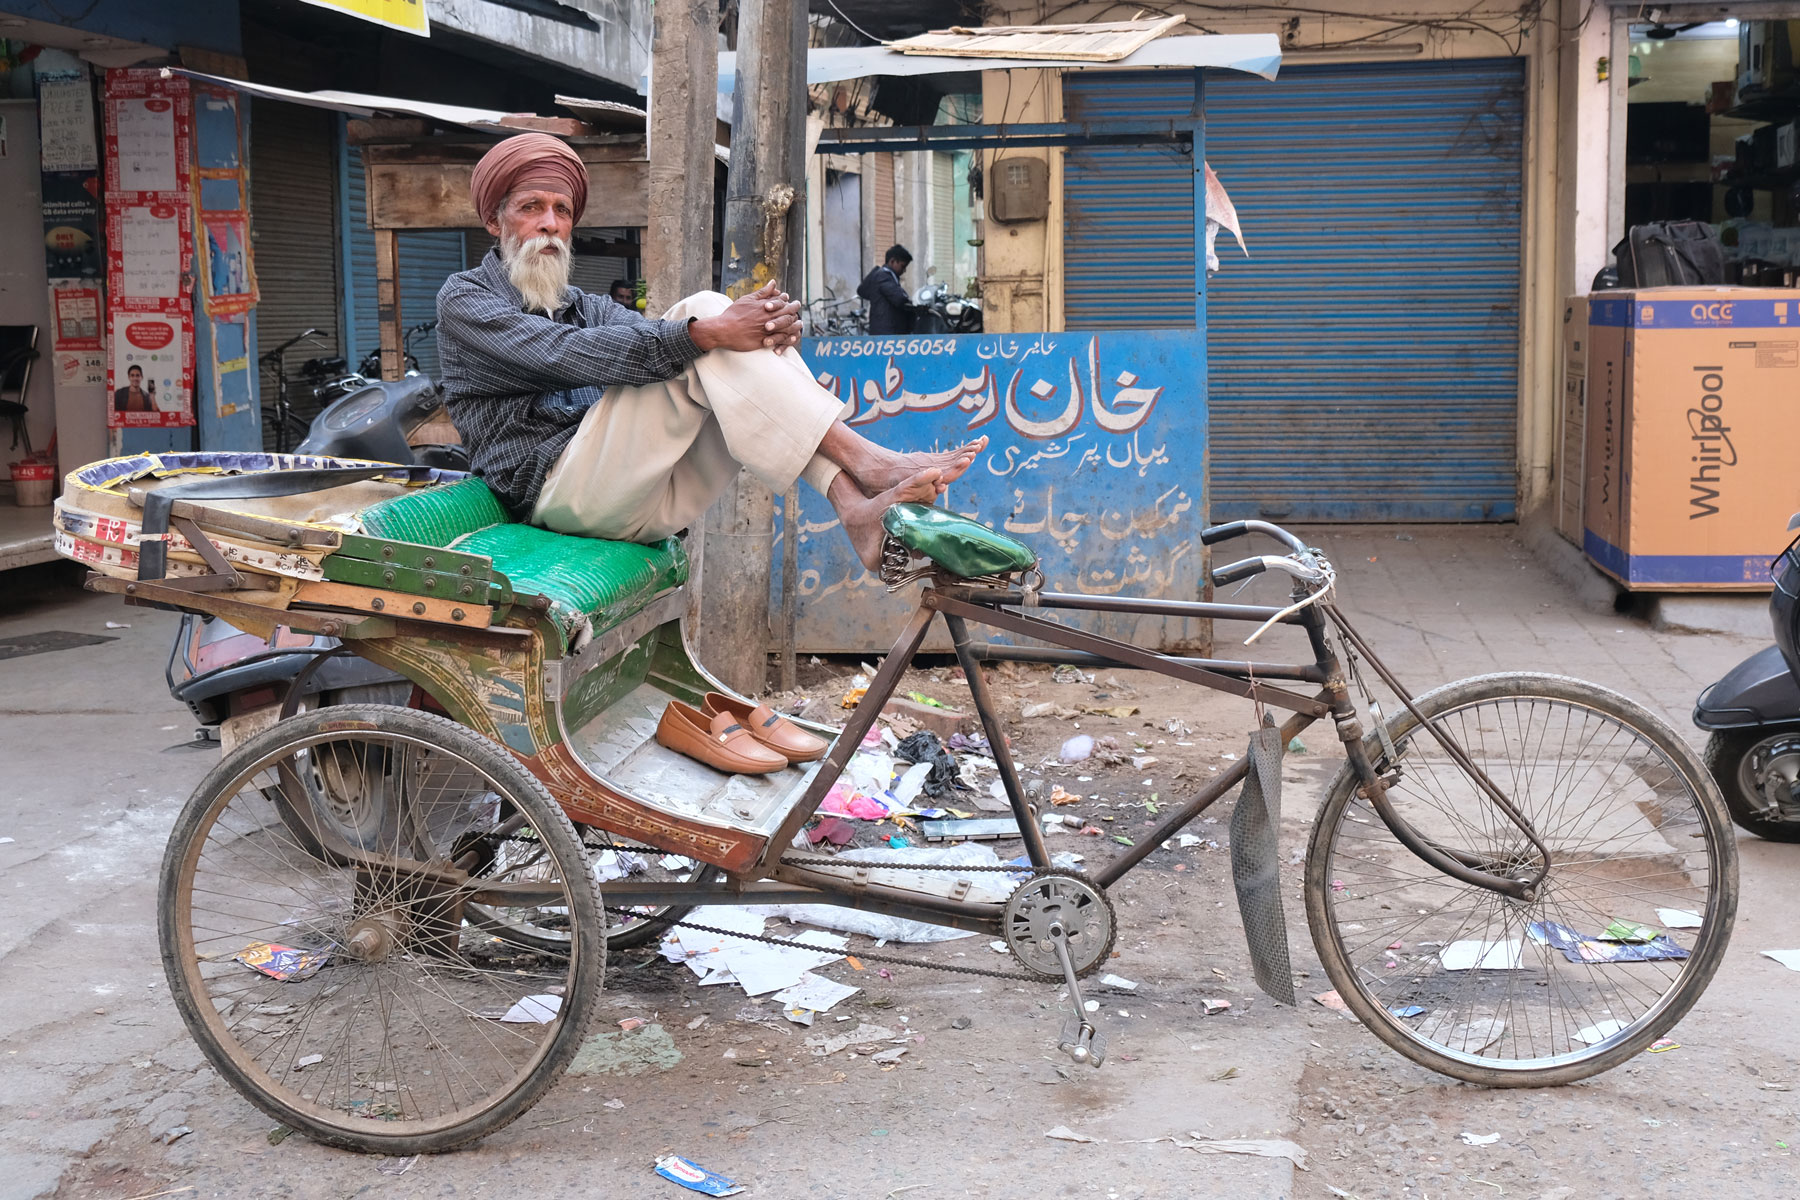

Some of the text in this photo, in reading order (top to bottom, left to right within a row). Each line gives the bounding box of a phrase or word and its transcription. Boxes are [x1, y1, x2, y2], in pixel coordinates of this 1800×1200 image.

[67, 207, 96, 216] everyday
[815, 339, 957, 357] M:9501556054
[977, 335, 1019, 360] خان
[1005, 335, 1166, 440] خان
[1072, 442, 1102, 477] پر
[1106, 430, 1170, 478] یہاں
[1689, 366, 1732, 520] Whirlpool
